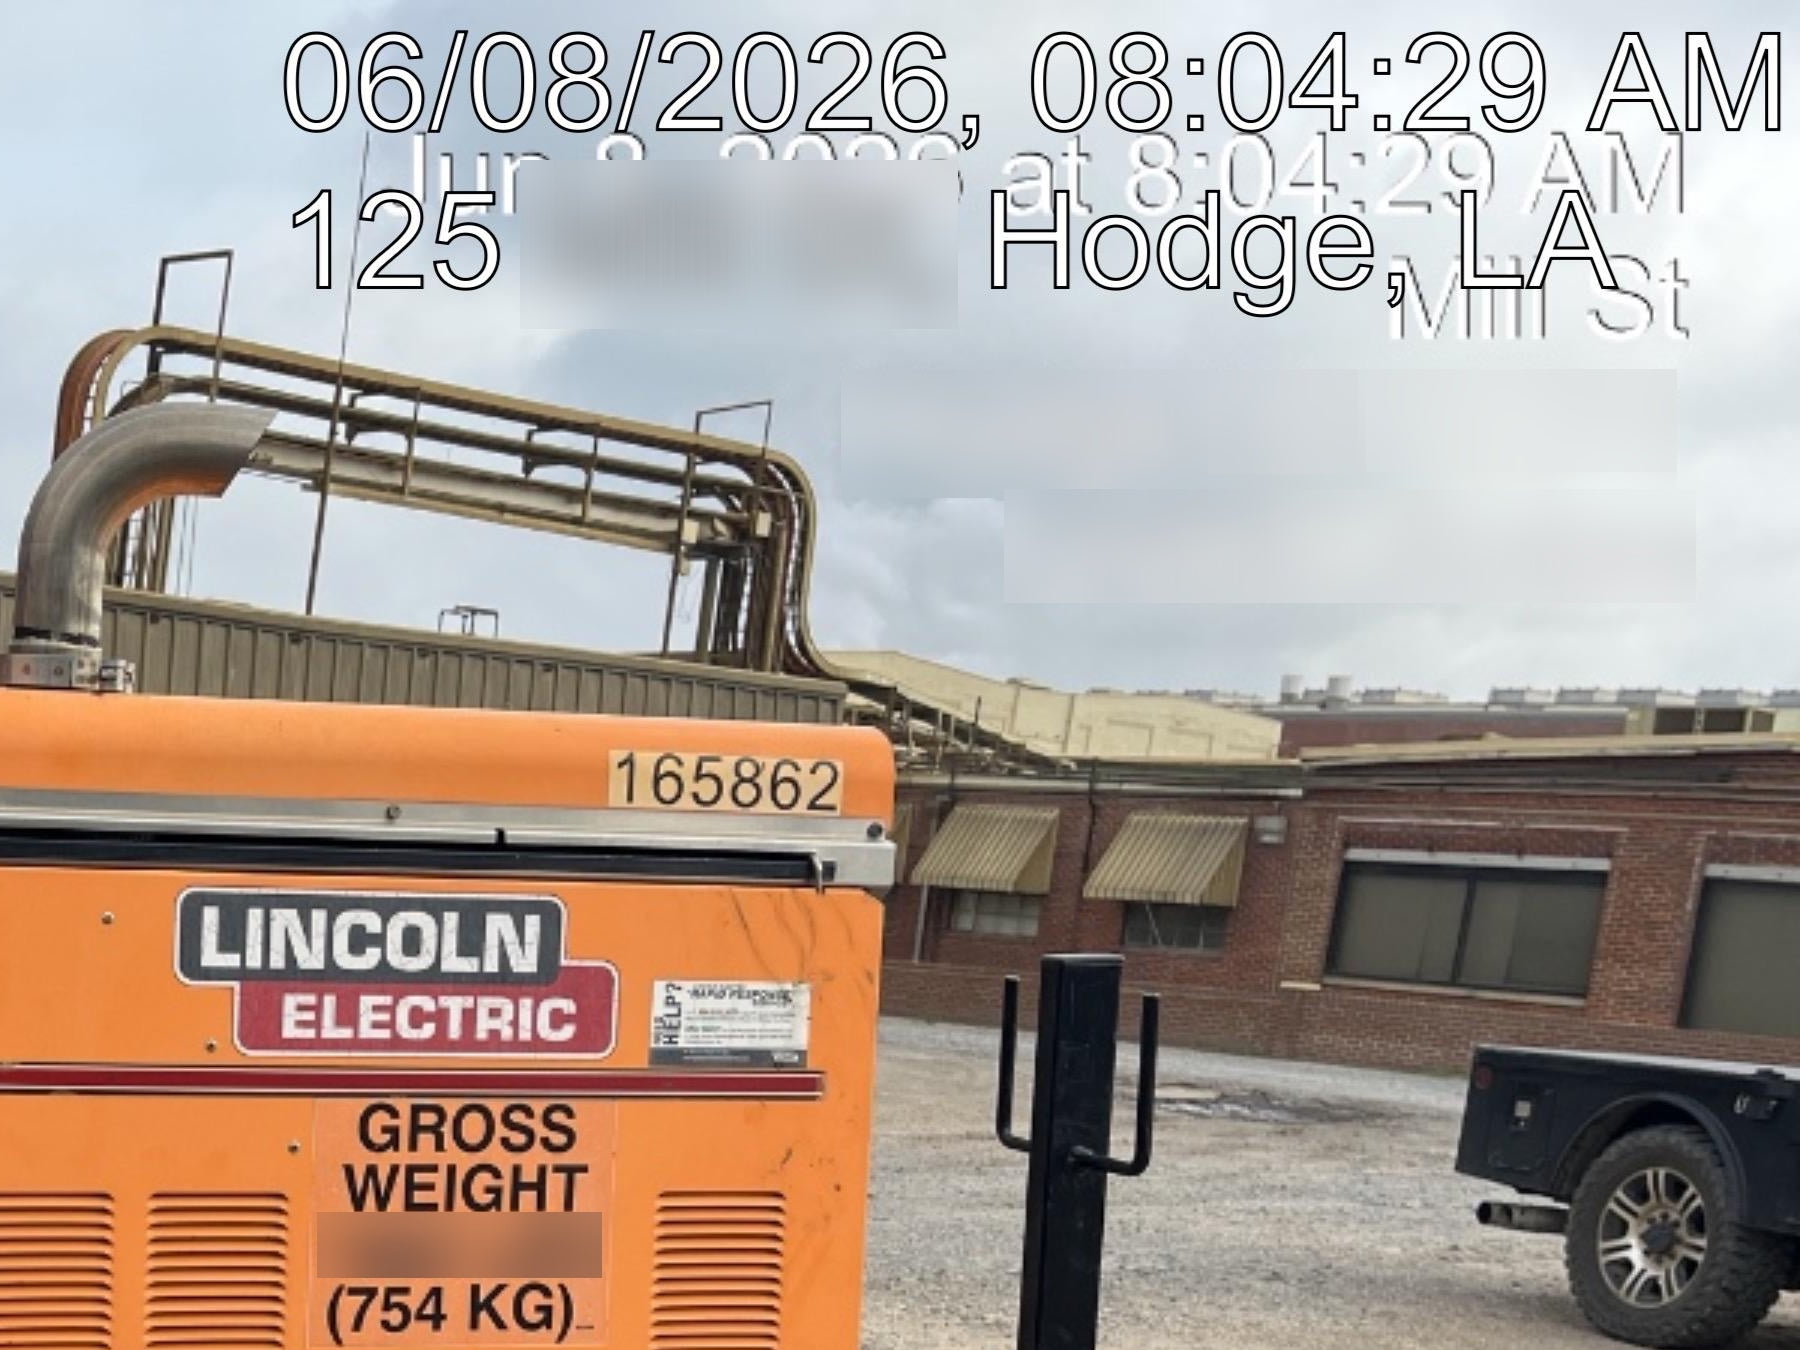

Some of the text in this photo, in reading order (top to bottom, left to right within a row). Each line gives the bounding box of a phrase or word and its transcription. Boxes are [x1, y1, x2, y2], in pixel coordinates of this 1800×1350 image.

[616, 752, 840, 811] 165862
[200, 905, 542, 974] LINCOLN
[281, 992, 578, 1042] ELECTRIC
[662, 983, 682, 1045] HELP?
[358, 1103, 578, 1153] GROSS
[342, 1163, 590, 1213] WEIGHT
[326, 1281, 575, 1347] (754 KG)
